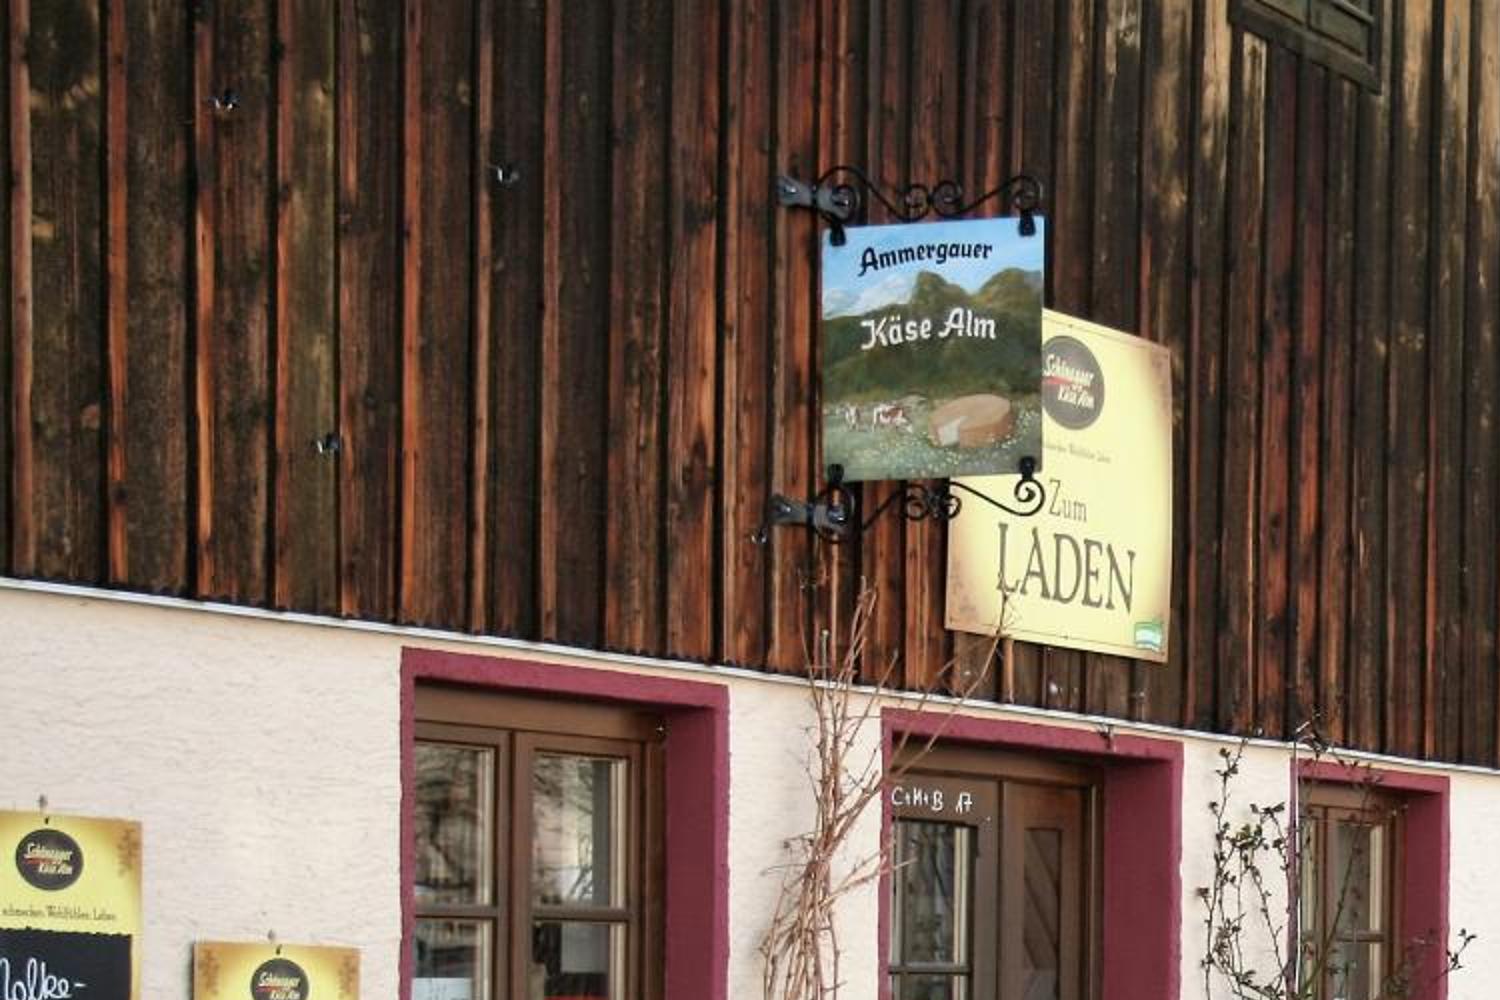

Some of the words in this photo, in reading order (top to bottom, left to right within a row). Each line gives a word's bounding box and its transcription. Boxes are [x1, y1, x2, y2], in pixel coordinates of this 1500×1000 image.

[857, 243, 993, 278] Ammergauer
[860, 315, 932, 350] Käse
[937, 306, 997, 340] Alm
[1048, 478, 1087, 522] Zum
[996, 521, 1136, 615] LADEN
